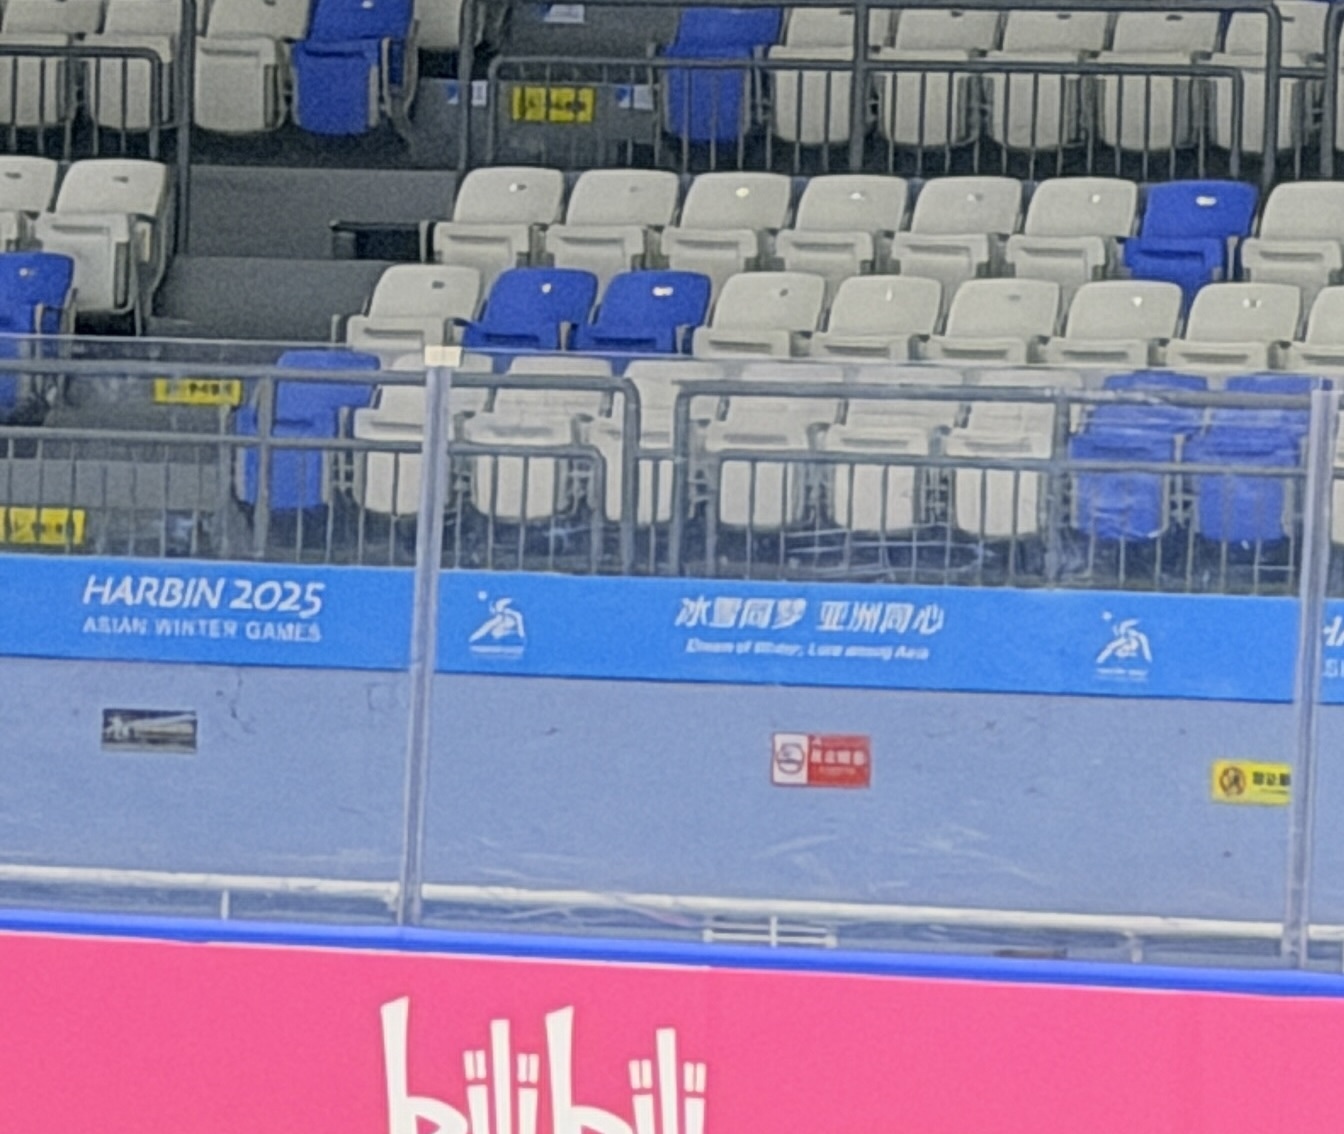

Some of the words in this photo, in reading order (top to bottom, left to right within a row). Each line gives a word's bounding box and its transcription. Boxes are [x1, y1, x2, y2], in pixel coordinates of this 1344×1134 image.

[83, 574, 225, 609] HARBIN
[229, 579, 326, 619] 2025
[83, 616, 147, 635] ASIAN
[155, 619, 237, 638] WINTER
[246, 621, 322, 643] GAMES
[816, 600, 944, 635] 亚洲同心
